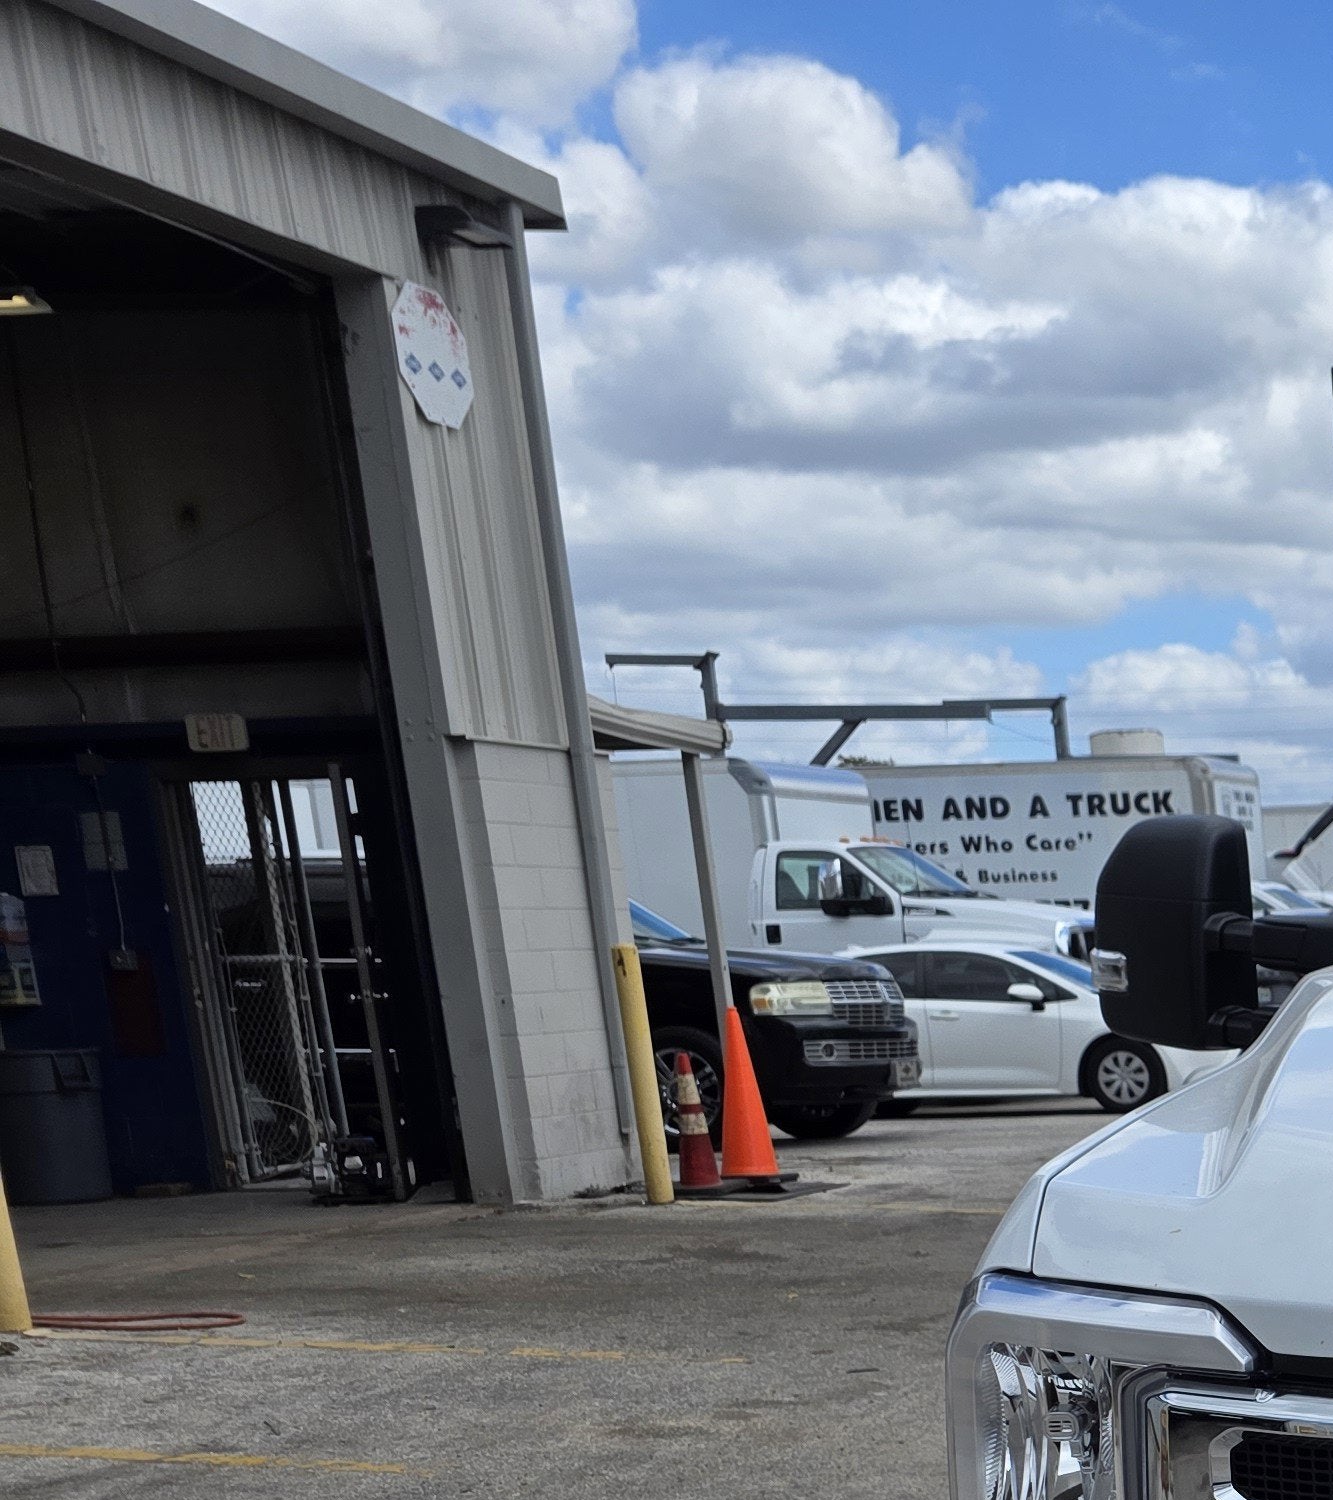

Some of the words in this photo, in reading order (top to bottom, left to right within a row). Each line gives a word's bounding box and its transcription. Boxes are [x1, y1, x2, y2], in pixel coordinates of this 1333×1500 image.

[942, 795, 1011, 821] AND
[1029, 794, 1050, 819] A
[1066, 790, 1175, 817] TRUCK
[960, 834, 1013, 854] Who
[978, 866, 1058, 884] Business
